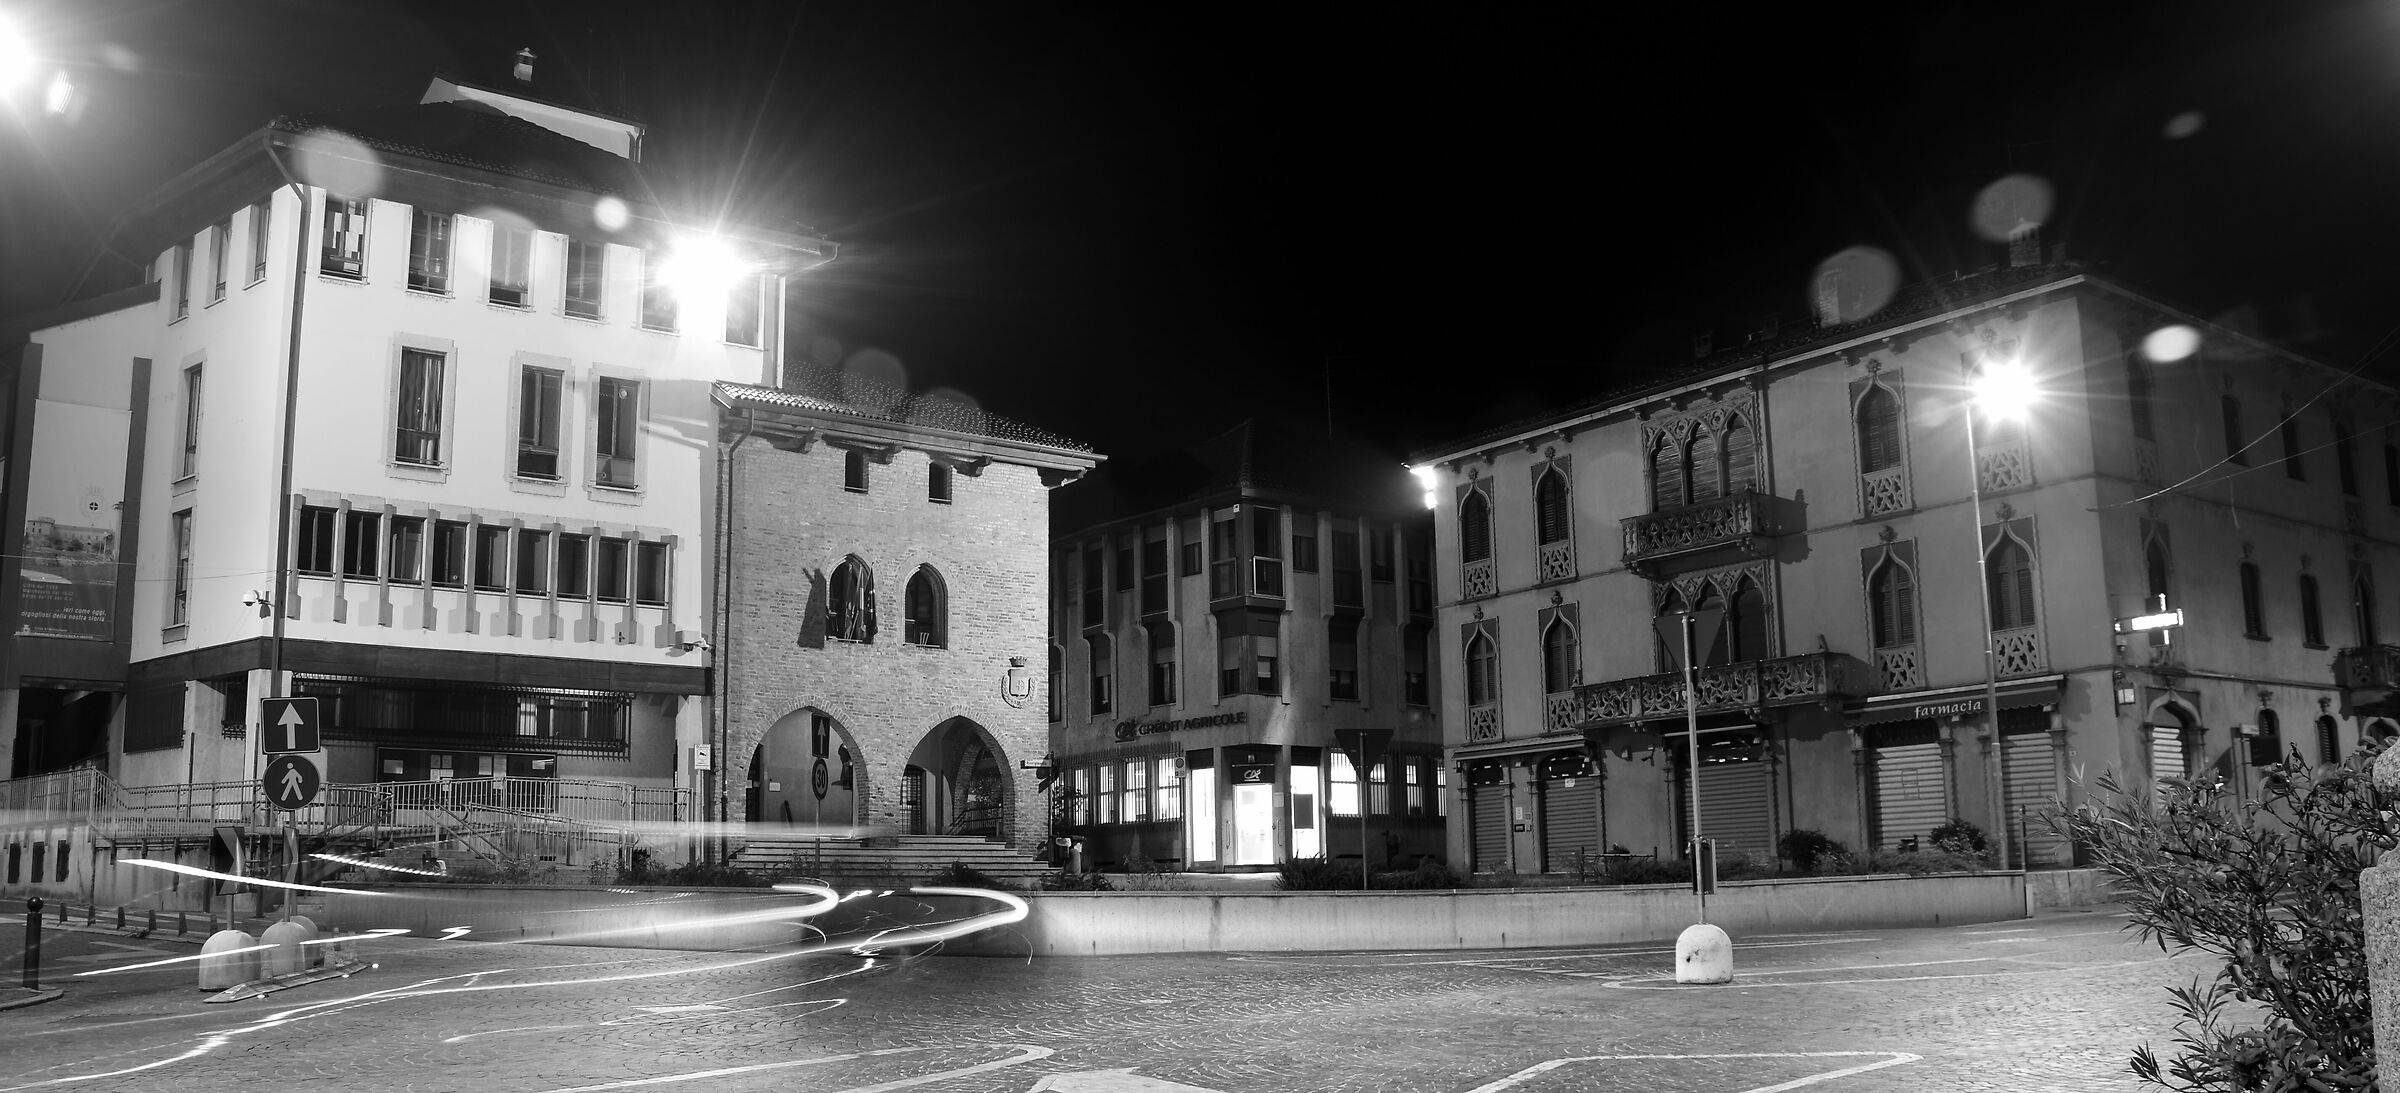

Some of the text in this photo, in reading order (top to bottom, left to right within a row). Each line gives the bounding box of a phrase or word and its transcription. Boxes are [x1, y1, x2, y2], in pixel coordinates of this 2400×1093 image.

[1914, 700, 1981, 719] farmacia
[1139, 719, 1182, 736] CRÉDIT
[1183, 711, 1247, 730] AGRICOLE
[816, 769, 826, 788] 30
